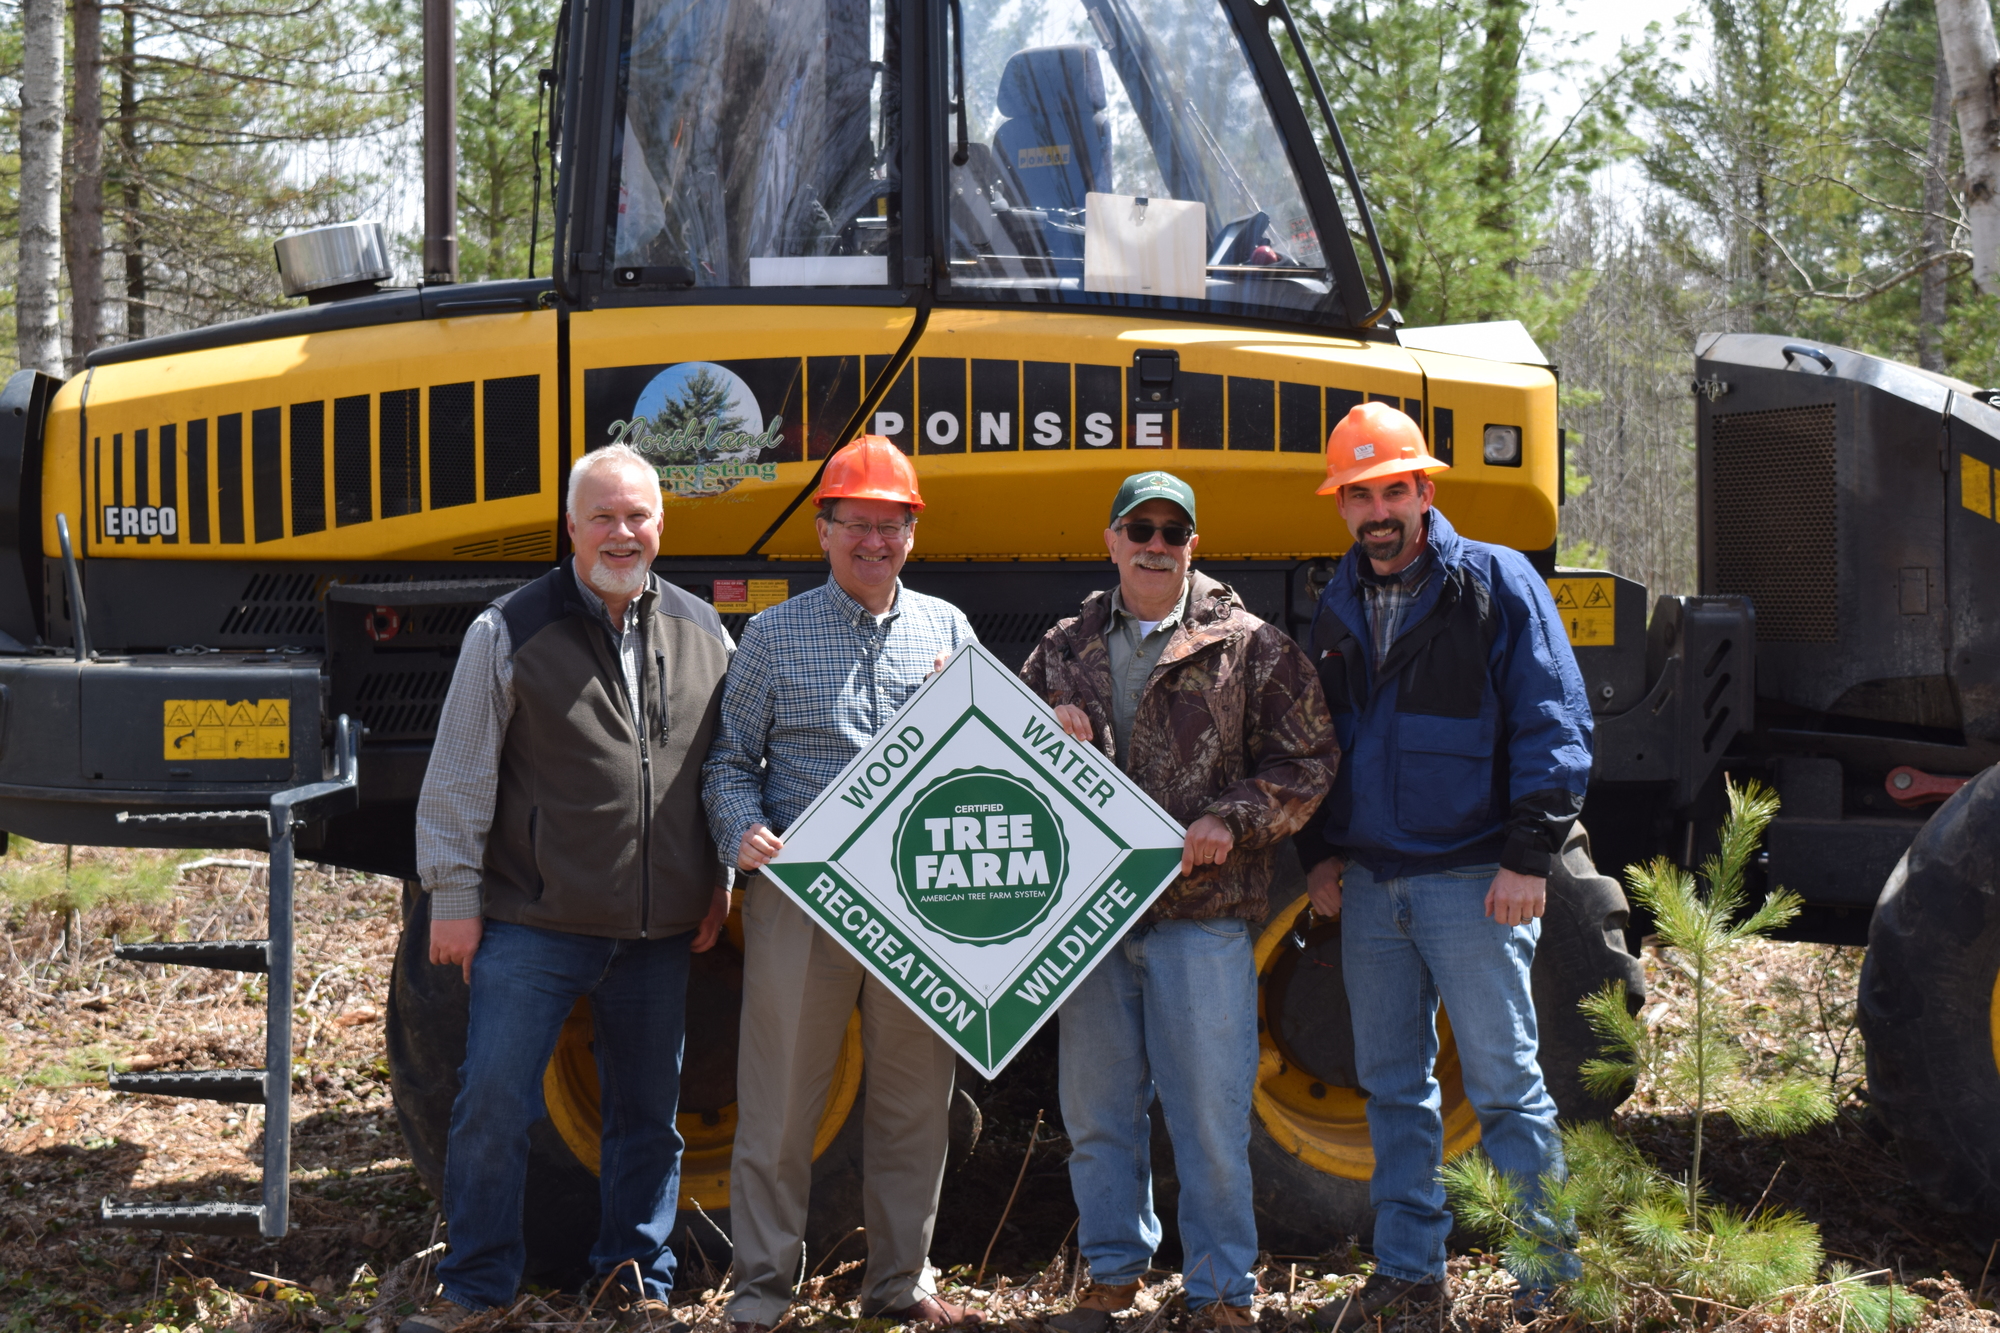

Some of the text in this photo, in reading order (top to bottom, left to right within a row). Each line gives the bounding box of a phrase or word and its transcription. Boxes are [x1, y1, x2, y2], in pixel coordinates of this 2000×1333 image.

[1020, 153, 1068, 166] PONSSE
[607, 415, 785, 453] Northland
[874, 411, 1163, 446] PONSSE
[671, 478, 725, 493] INC.
[105, 506, 177, 536] ERGO
[840, 726, 924, 809] WOOD
[1022, 715, 1115, 808] WATER
[954, 803, 1004, 814] CERTIFIED
[924, 814, 1034, 852] TREE
[915, 850, 1051, 890] FARM
[920, 890, 1046, 903] AMERICAN TREE FARM SYSTEM
[806, 872, 977, 1032] RECREATION
[1015, 878, 1137, 1006] WILDLIFE
